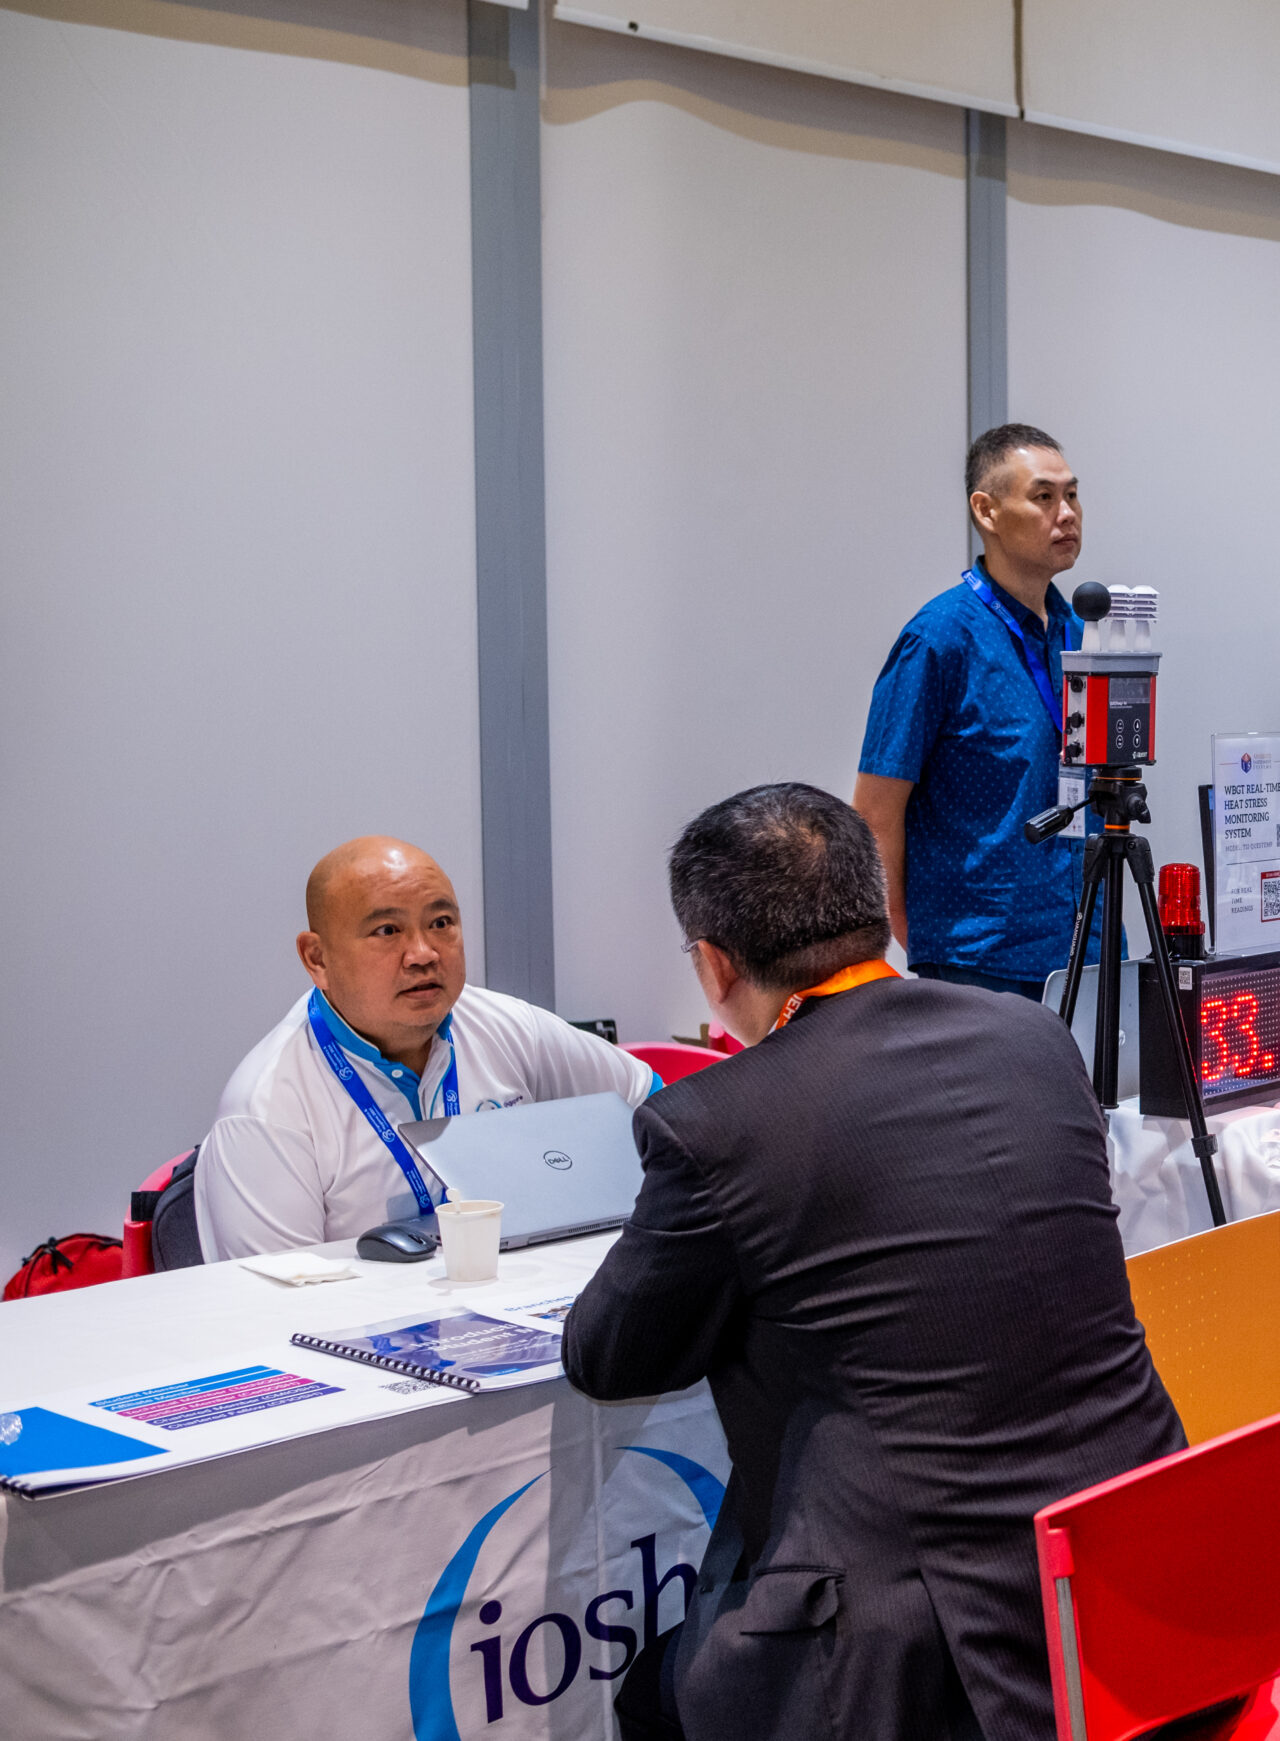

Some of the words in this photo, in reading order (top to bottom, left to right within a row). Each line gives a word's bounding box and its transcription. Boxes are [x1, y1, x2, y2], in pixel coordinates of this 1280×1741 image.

[1224, 784, 1245, 796] WBGT
[1224, 799, 1243, 810] HEAT
[1244, 797, 1268, 809] STRESS
[1224, 811, 1270, 825] MONITORING
[1225, 827, 1252, 840] SYSTEM
[547, 1156, 570, 1165] DELL
[95, 1393, 141, 1406] Student
[141, 1383, 190, 1396] Member
[110, 1398, 154, 1411] Affiliate
[153, 1388, 202, 1401] Member
[125, 1400, 181, 1415] Technical
[179, 1390, 227, 1405] Member
[187, 1396, 236, 1410] Member
[152, 1408, 213, 1425] Chartered
[211, 1398, 259, 1412] Member
[167, 1414, 227, 1430] Chartered
[226, 1405, 266, 1416] Fellow
[470, 1532, 699, 1725] iosh
